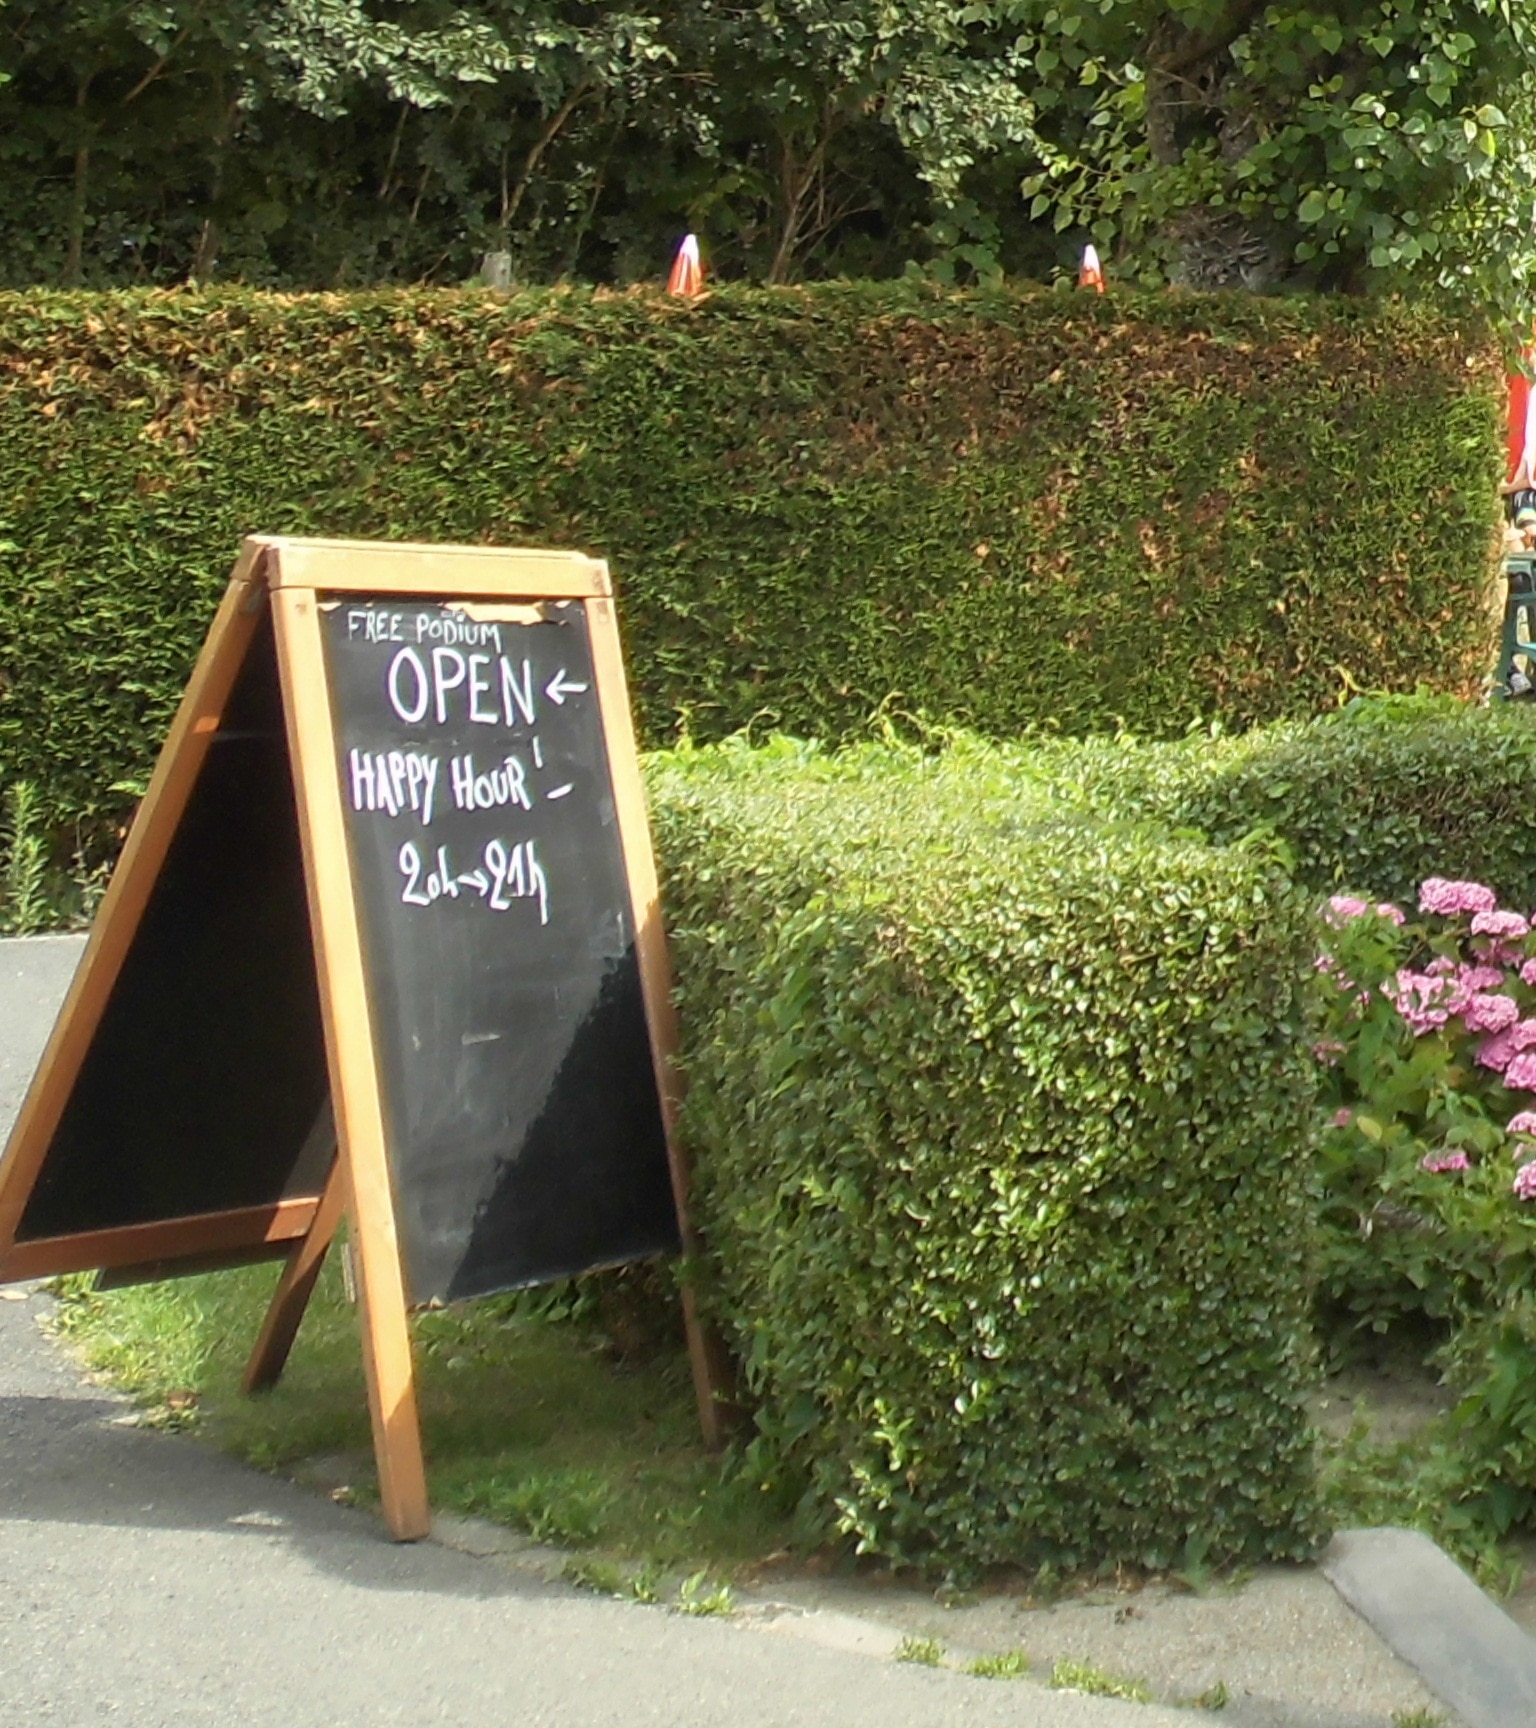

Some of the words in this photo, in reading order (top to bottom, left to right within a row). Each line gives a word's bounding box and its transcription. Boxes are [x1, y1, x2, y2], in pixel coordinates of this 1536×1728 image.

[347, 609, 404, 644] FREE
[388, 645, 536, 727] OPEN
[350, 748, 439, 825] HAPPY
